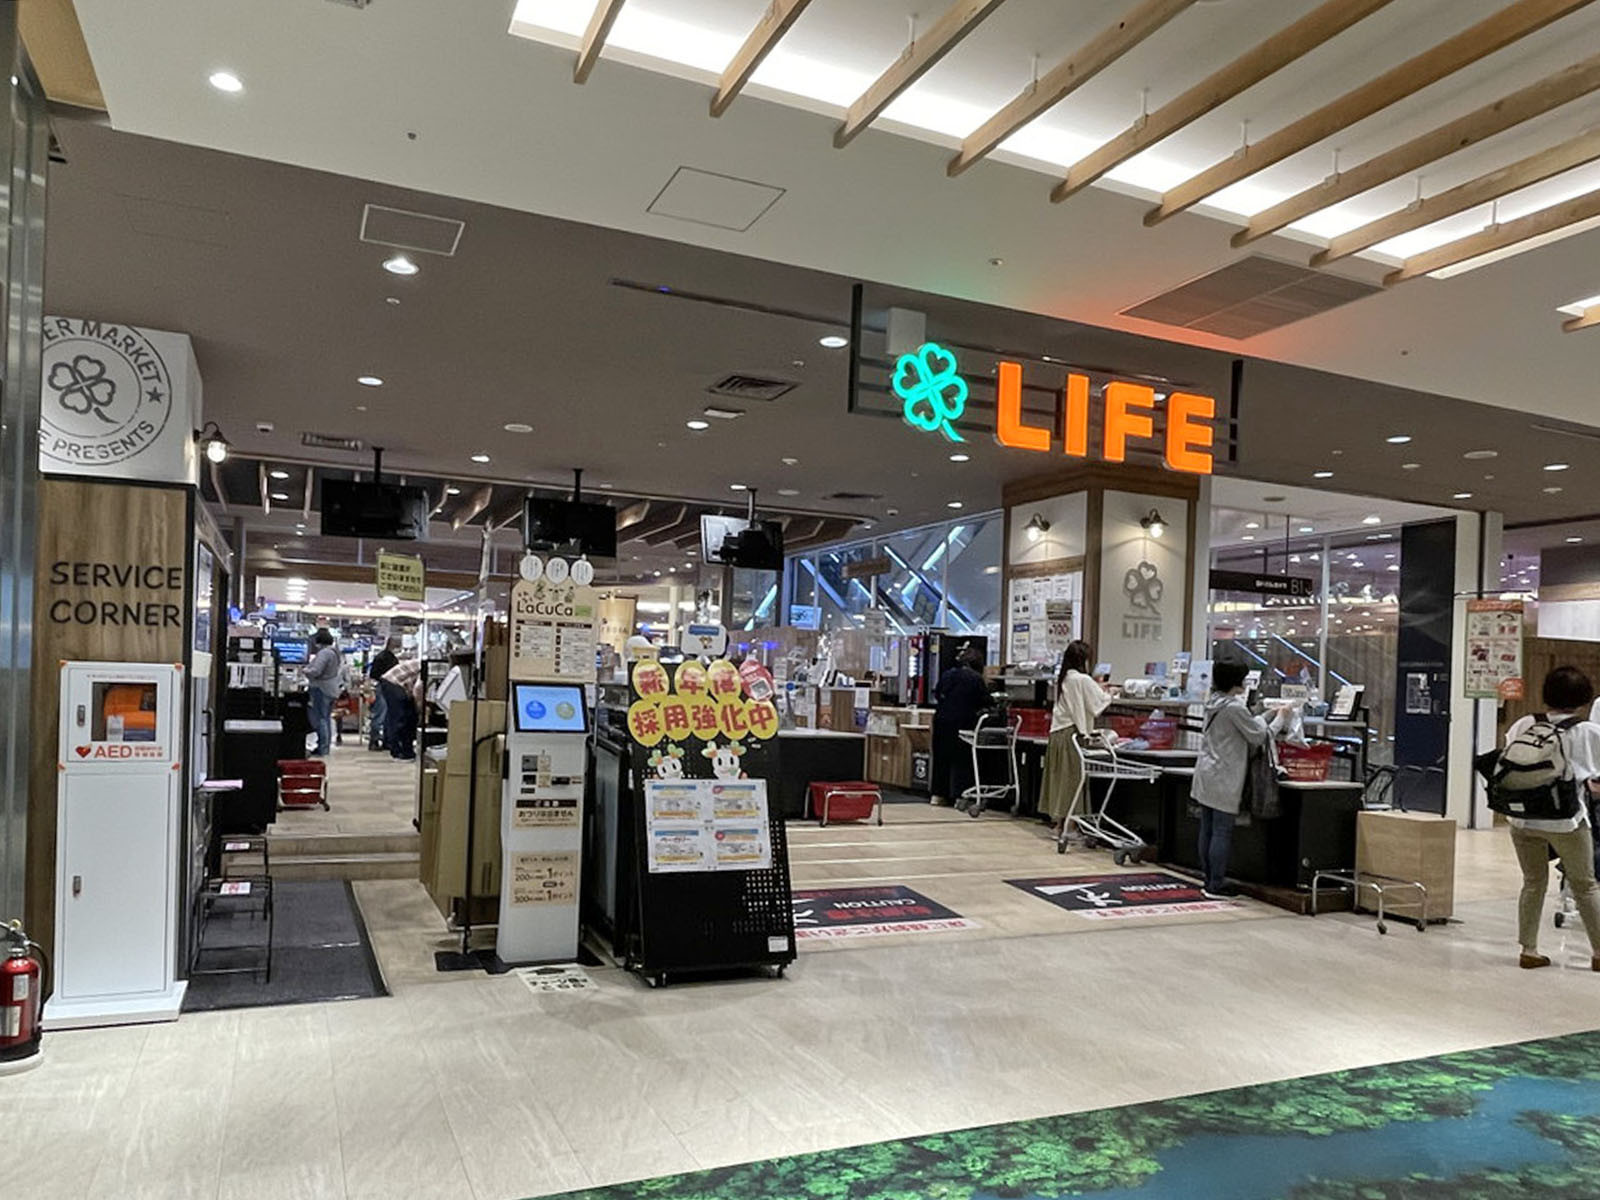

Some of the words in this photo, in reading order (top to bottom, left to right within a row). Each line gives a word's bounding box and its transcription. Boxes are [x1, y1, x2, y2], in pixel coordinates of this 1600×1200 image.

[81, 320, 162, 384] MARKET
[997, 361, 1216, 475] LIFE
[52, 420, 154, 460] PRESENTS
[50, 561, 183, 590] SERVICE
[50, 601, 182, 628] CORNER
[517, 601, 573, 616] LaCuCa
[1122, 622, 1162, 641] LIFE
[633, 703, 775, 737] 採用強化中
[94, 745, 132, 759] AED
[833, 898, 916, 910] CAUTION
